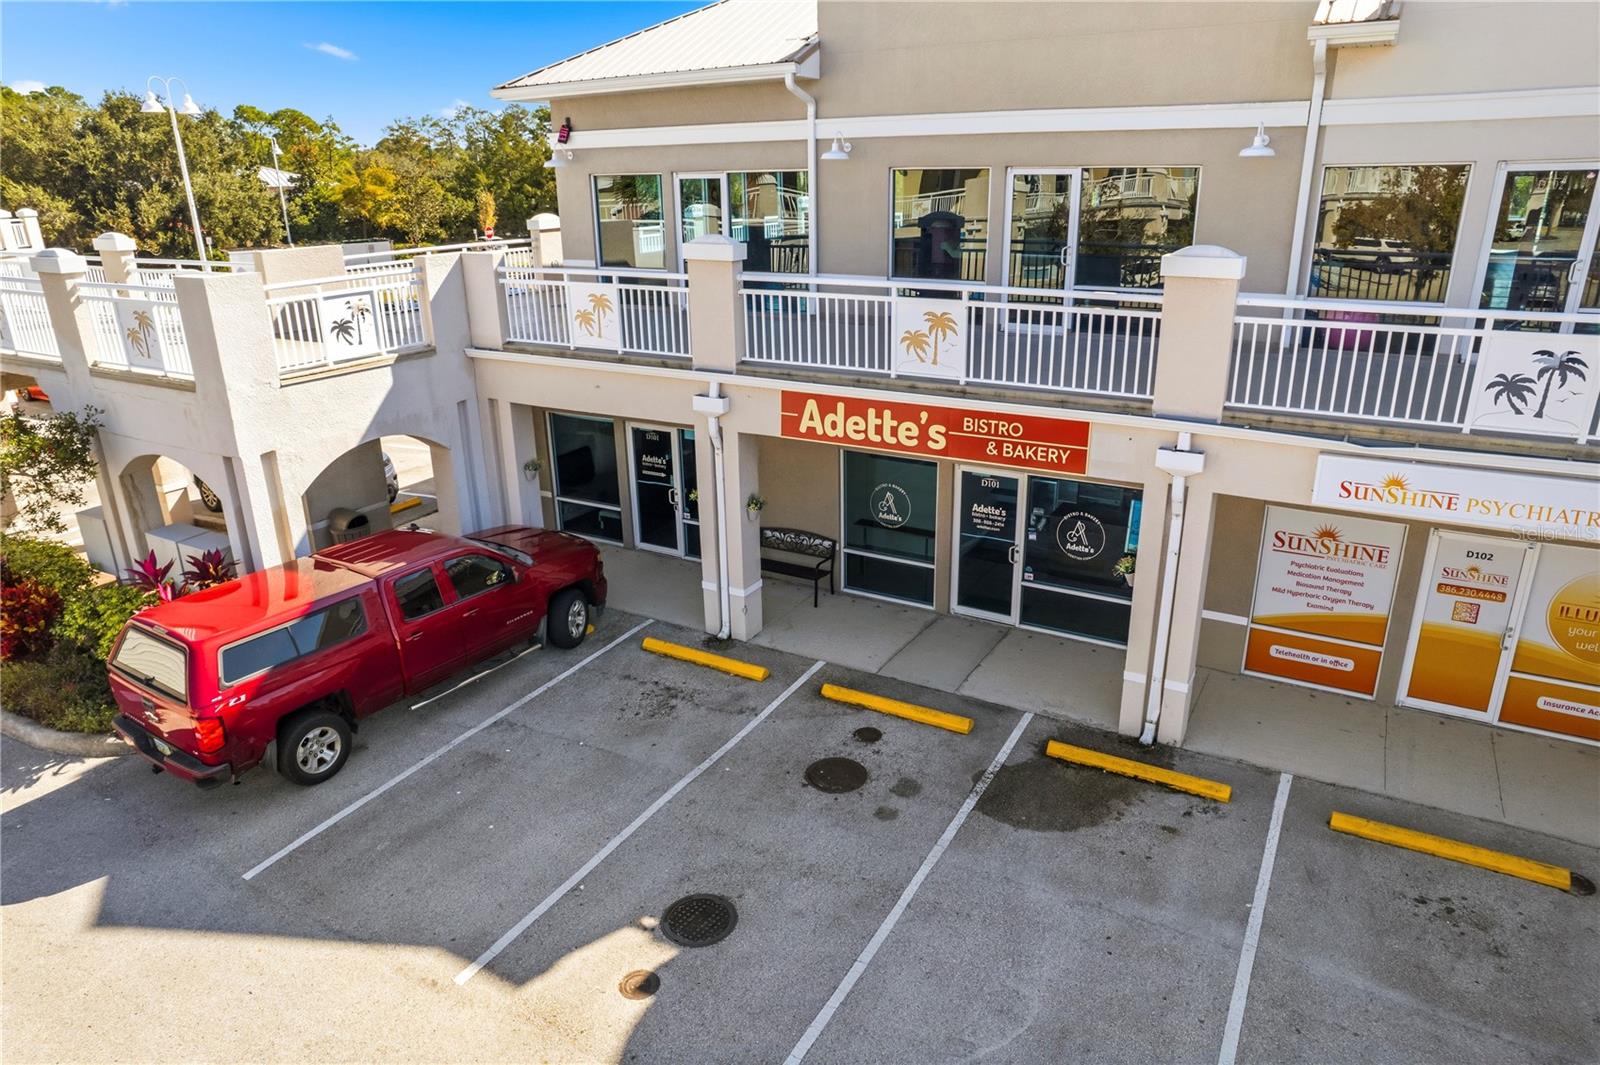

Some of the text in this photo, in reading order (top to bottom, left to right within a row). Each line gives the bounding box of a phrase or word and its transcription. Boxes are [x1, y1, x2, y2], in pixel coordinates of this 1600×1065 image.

[799, 398, 947, 451] Adette's
[963, 417, 1023, 437] BISTRO
[986, 442, 1071, 465] & BAKERY
[981, 479, 1000, 489] D101
[972, 503, 1007, 517] Adette's
[1465, 497, 1600, 528] PSYCHIATR
[1066, 543, 1095, 553] Adette's
[1466, 550, 1494, 561] D102
[1290, 560, 1364, 577] Psychiatric Evaluations
[1287, 570, 1365, 588] Medication Management
[1295, 580, 1352, 597] Biosound Therapy
[1439, 584, 1504, 601] 386.230.4448
[1271, 586, 1375, 610] Mild Hyperbaric Oxygen Therapy
[1560, 605, 1600, 624] ILLU
[1568, 626, 1599, 638] your
[1274, 647, 1311, 660] Telehealth
[1329, 659, 1349, 668] office
[1543, 699, 1600, 717] Insurance Ac
